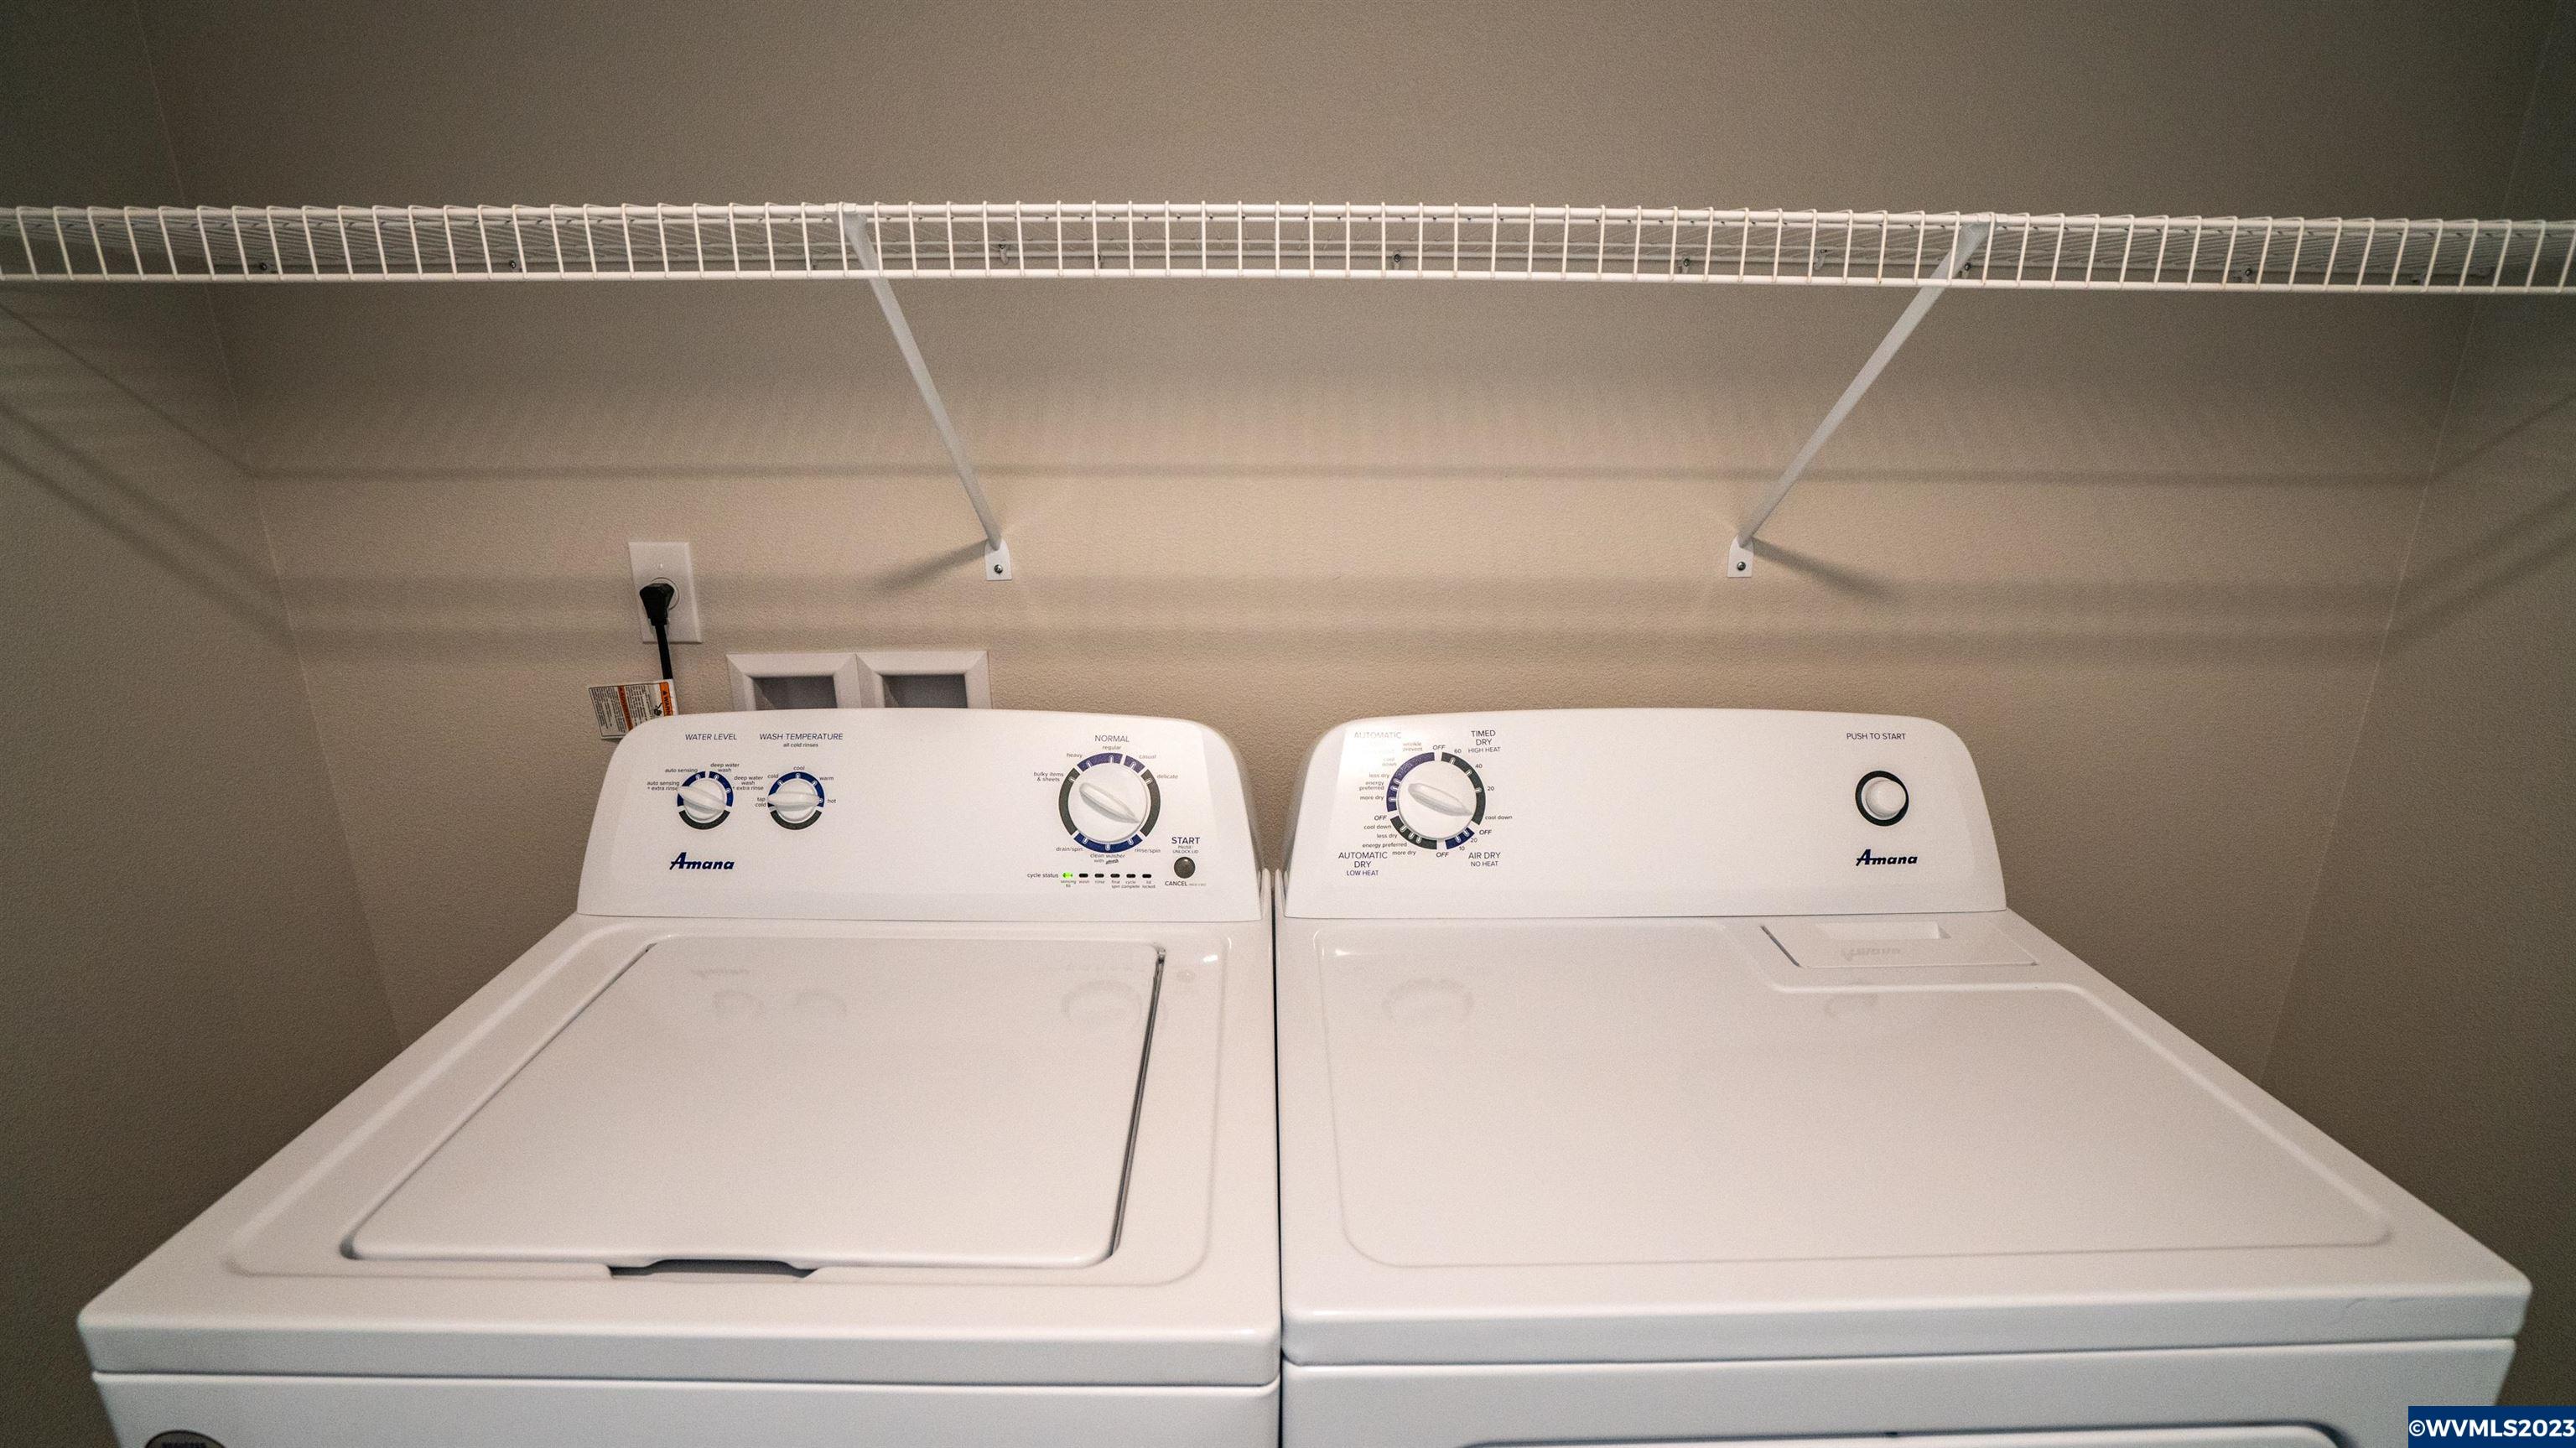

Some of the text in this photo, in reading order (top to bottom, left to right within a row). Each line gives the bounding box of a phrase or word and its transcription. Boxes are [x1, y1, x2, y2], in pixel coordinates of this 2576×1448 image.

[1471, 729, 1496, 738] TIMED
[669, 852, 735, 870] Amana
[1856, 849, 1918, 866] Amana
